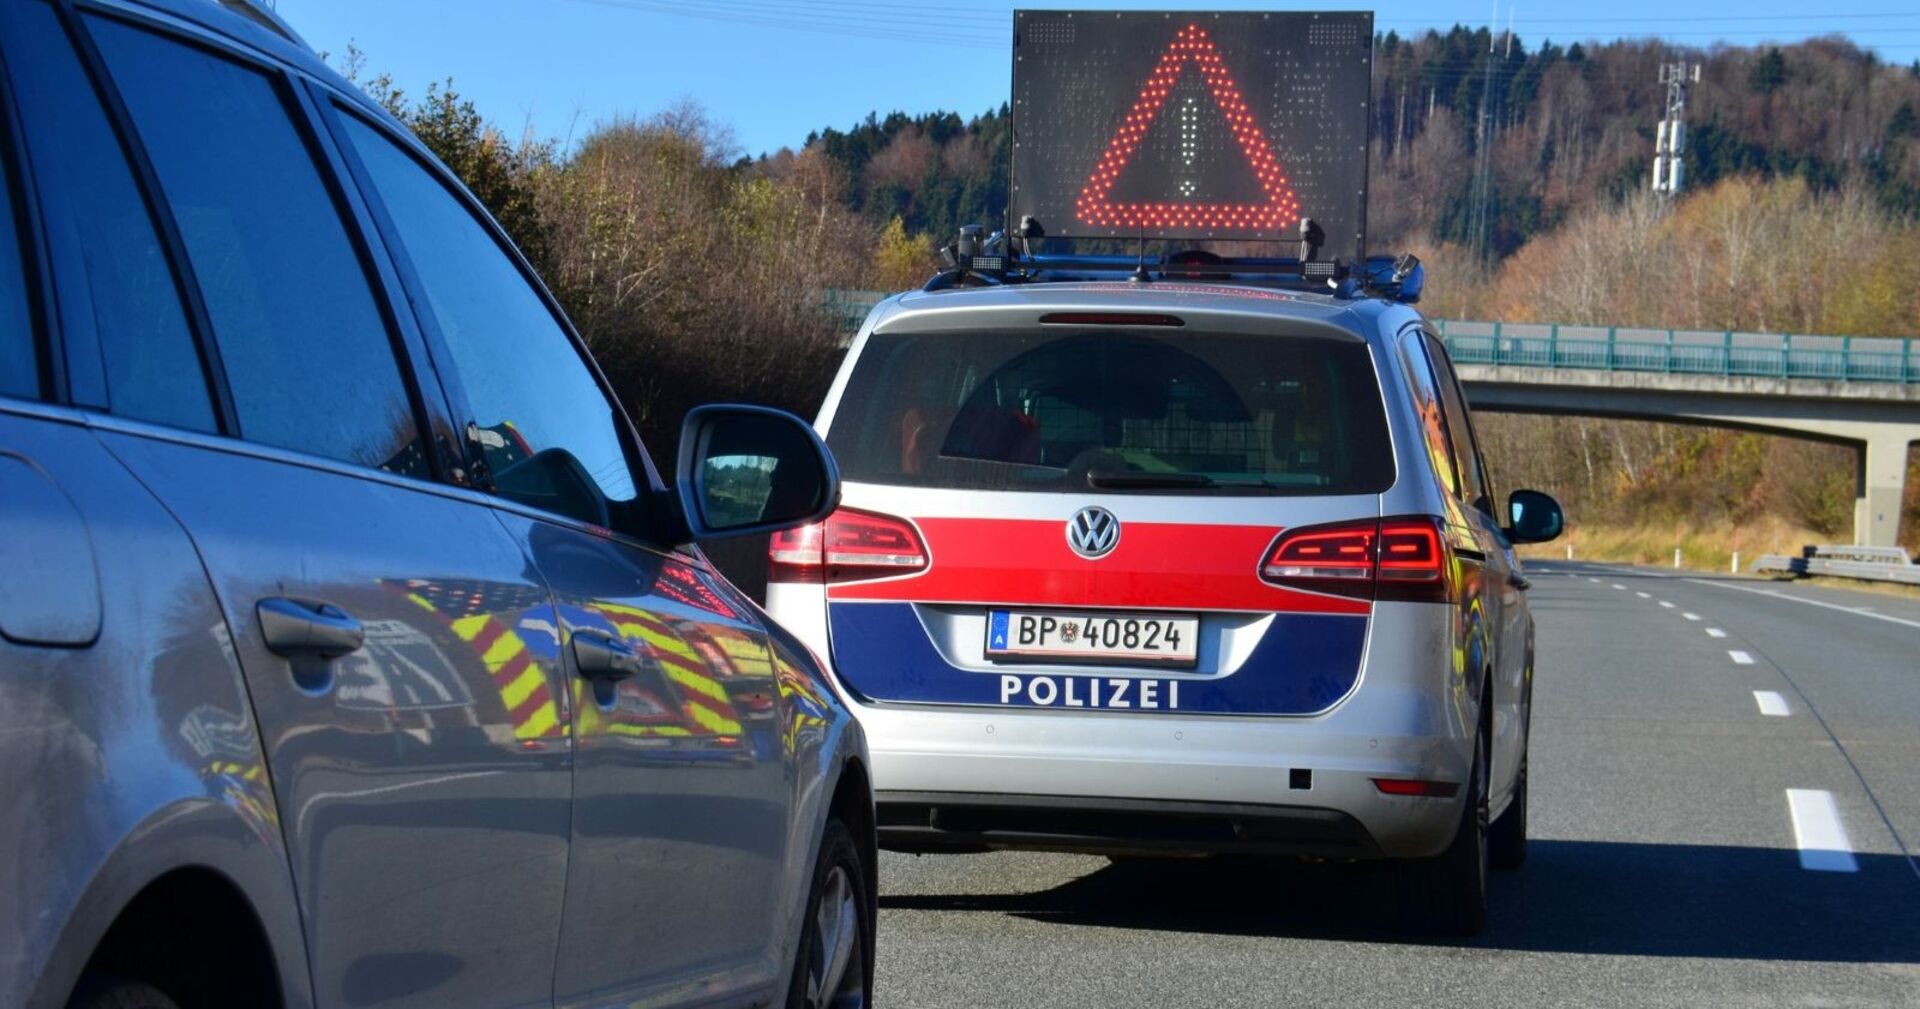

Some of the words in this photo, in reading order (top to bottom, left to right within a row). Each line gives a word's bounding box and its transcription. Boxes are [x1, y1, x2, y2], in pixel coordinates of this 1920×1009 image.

[1068, 508, 1119, 555] VW
[995, 635, 1003, 644] A
[1019, 616, 1056, 645] BP
[1083, 618, 1180, 650] 40824
[1001, 675, 1178, 708] POLIZEI
